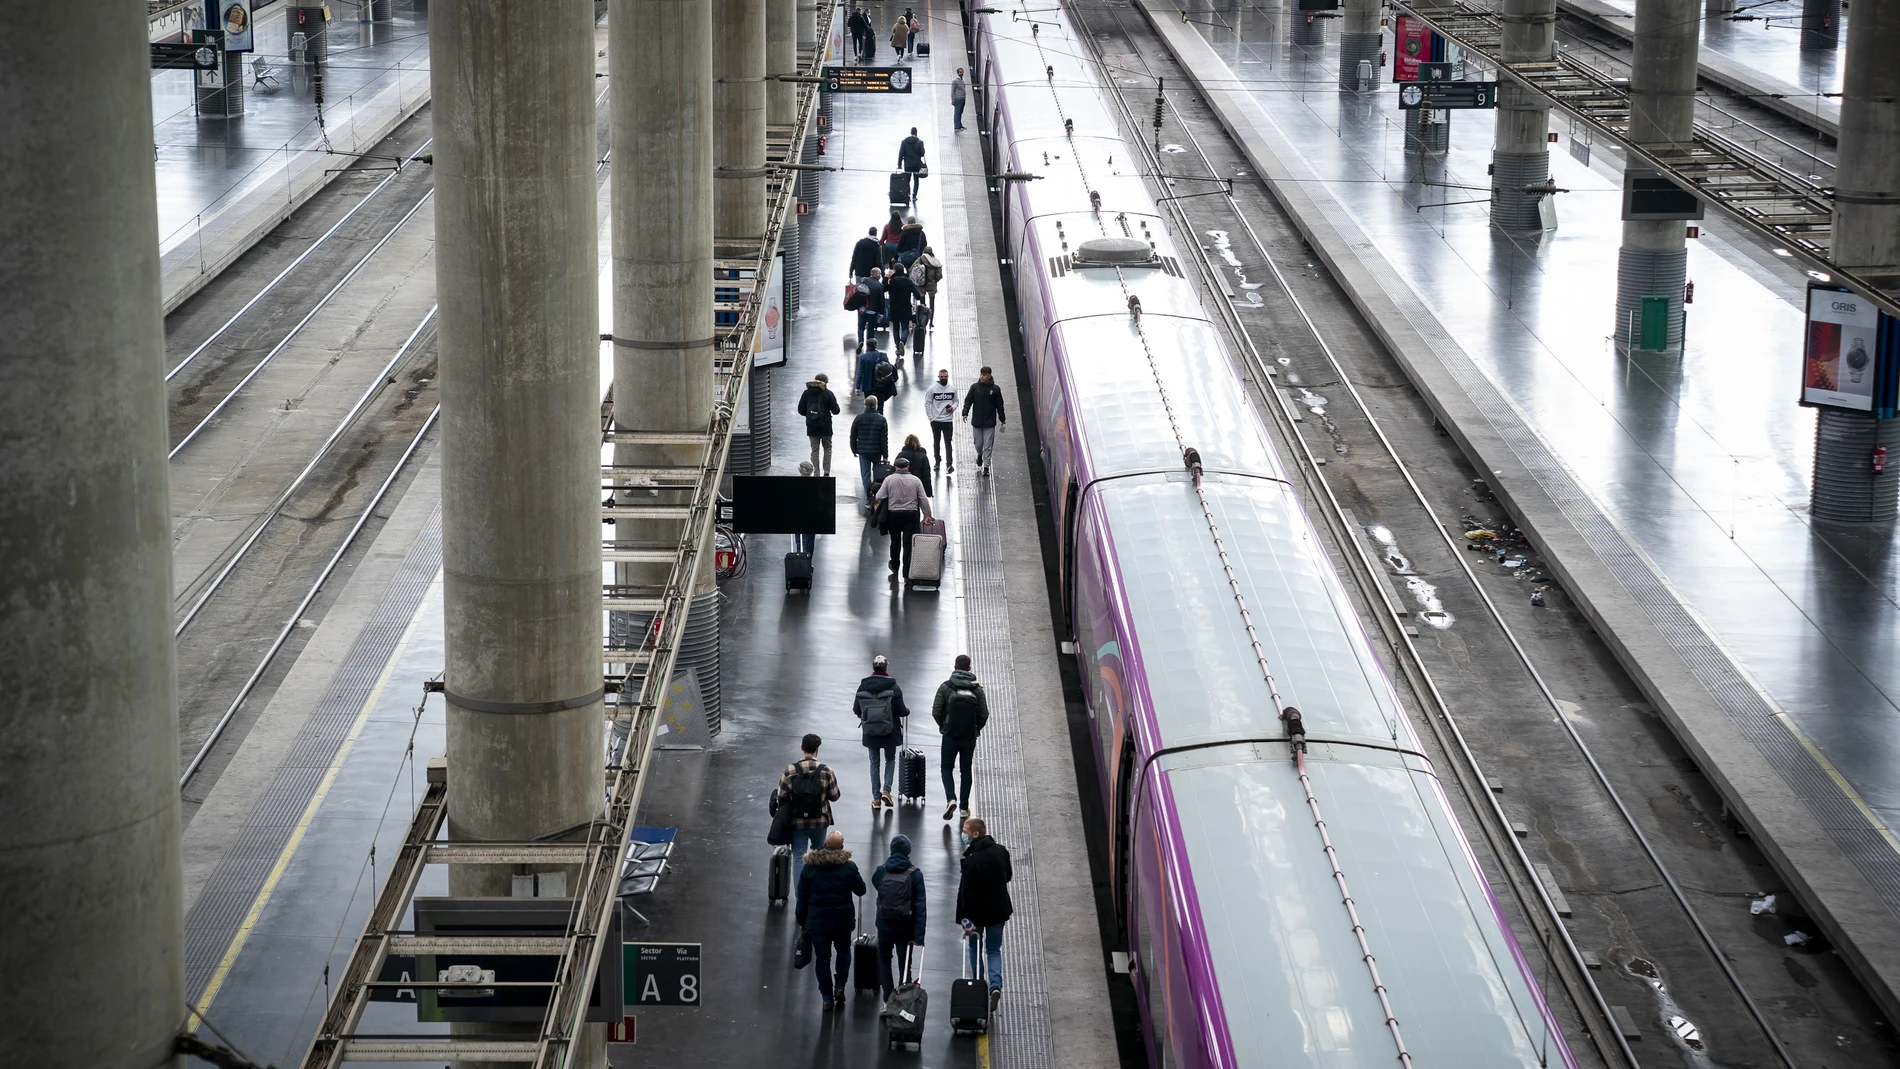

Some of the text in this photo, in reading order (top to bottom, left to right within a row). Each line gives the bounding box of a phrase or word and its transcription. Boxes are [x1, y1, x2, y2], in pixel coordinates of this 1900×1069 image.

[1477, 93, 1486, 106] 9
[1831, 301, 1856, 312] ORIS
[676, 947, 687, 955] Vía
[395, 971, 416, 999] A
[640, 974, 698, 1003] A 8
